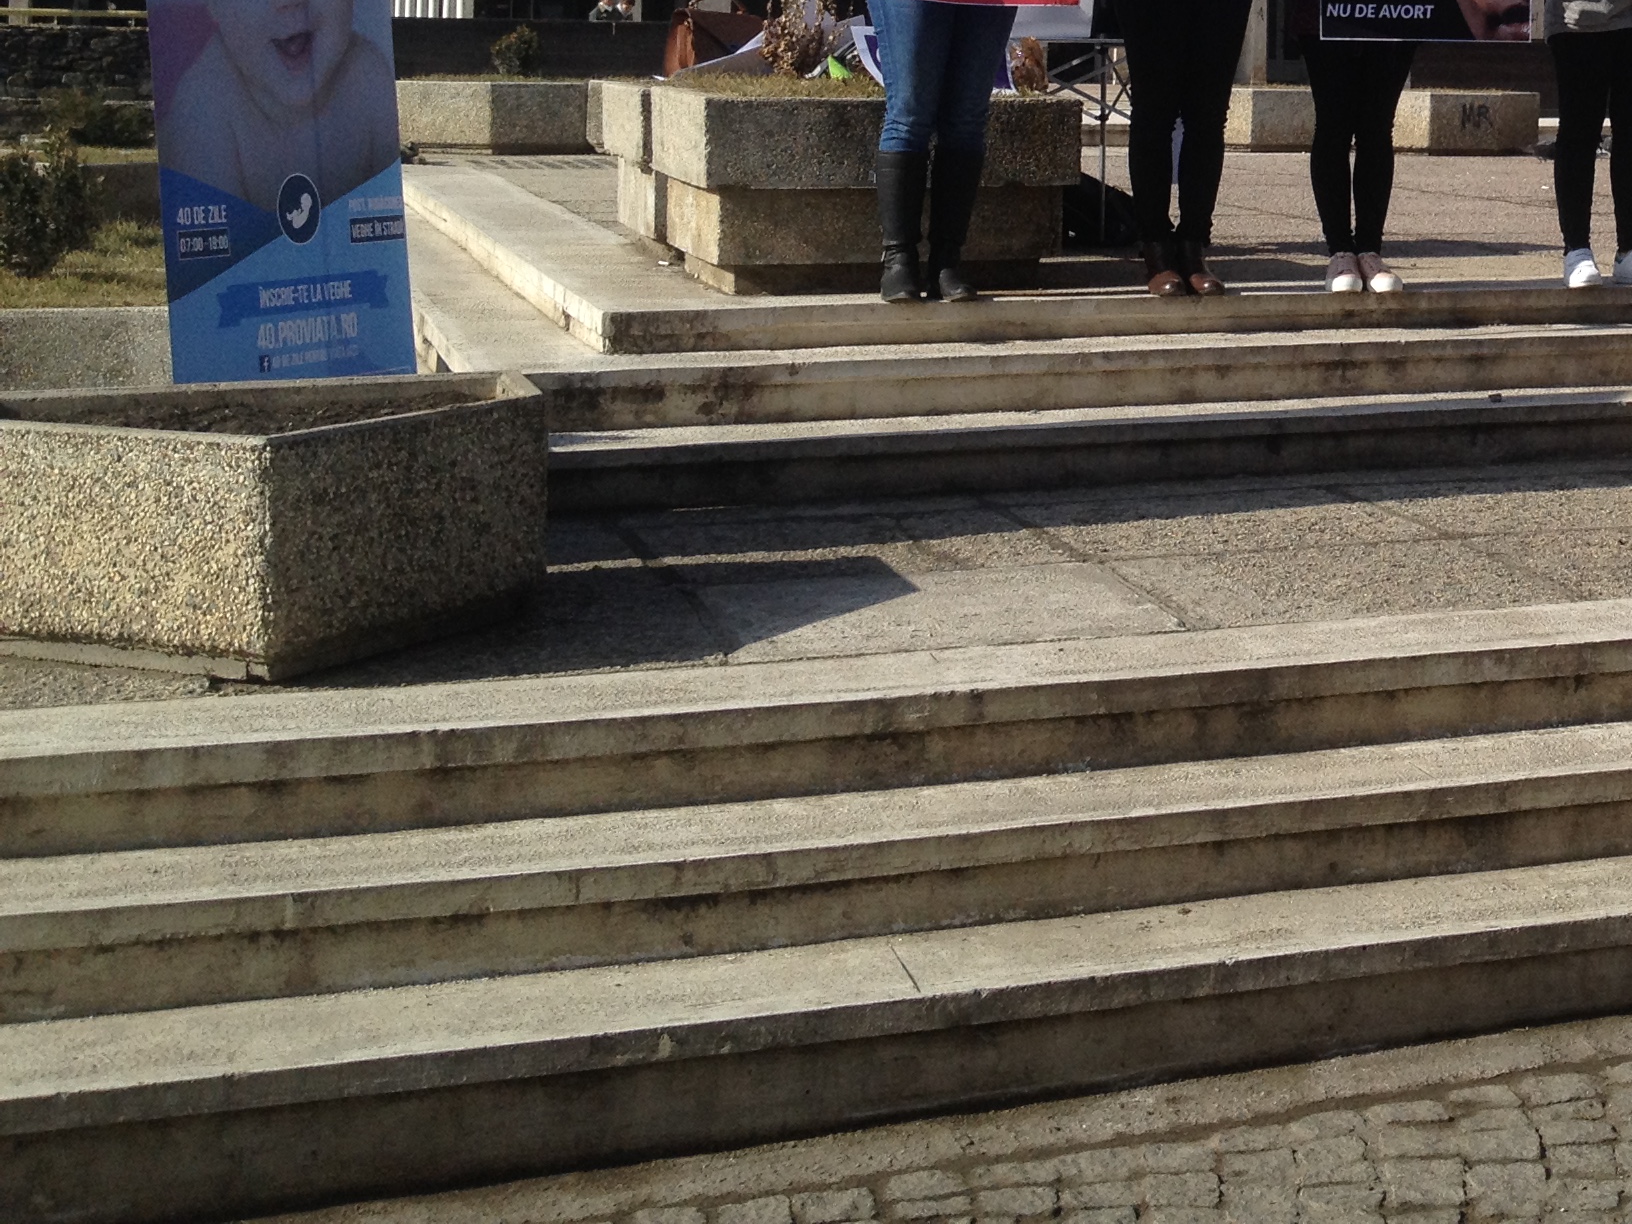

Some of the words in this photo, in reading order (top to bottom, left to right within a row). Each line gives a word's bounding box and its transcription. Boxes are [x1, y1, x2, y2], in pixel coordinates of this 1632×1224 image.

[1326, 3, 1351, 18] NU
[1355, 4, 1377, 18] DE
[1378, 4, 1434, 20] AVORT
[176, 207, 192, 224] 40
[194, 206, 206, 224] DE
[208, 204, 228, 224] ZILE
[180, 236, 204, 253] 07:00
[259, 285, 310, 309] ÎNSCRIE-TE
[310, 283, 323, 304] LA
[324, 280, 352, 301] VEGHE
[258, 312, 358, 350] 40.PROVIATA.RO
